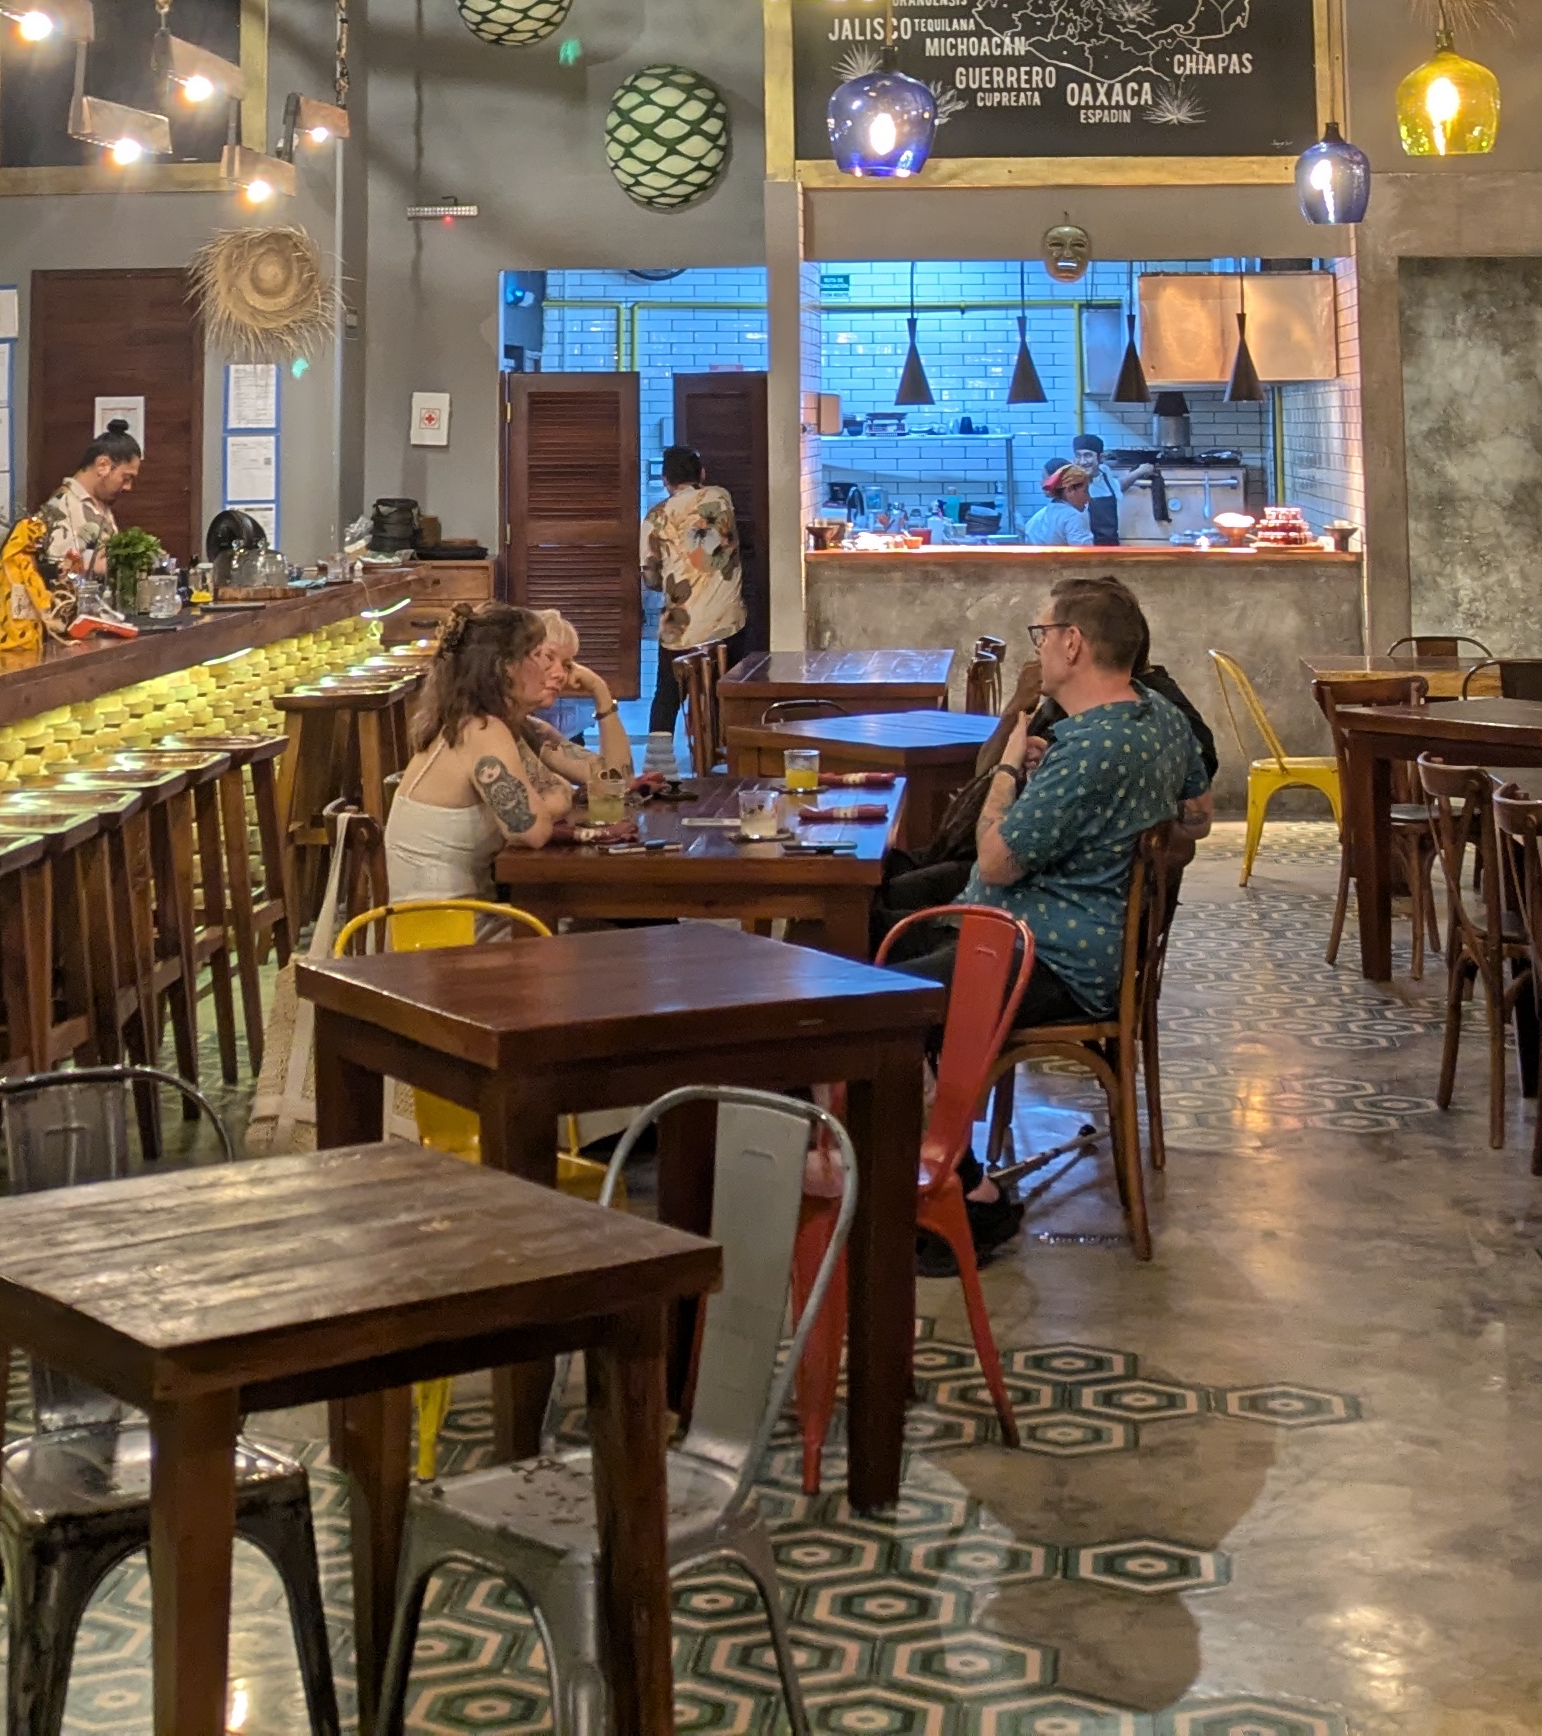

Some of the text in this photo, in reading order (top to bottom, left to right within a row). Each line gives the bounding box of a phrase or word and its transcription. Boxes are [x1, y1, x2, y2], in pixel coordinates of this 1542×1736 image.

[828, 18, 976, 41] JALISCO TEQUILANA
[1173, 53, 1254, 75] CHIAPAS
[955, 66, 1057, 89] GUERRERO
[976, 91, 1042, 107] CUPREATA
[1066, 82, 1153, 106] OAXACA
[1079, 109, 1132, 124] ESPADIN
